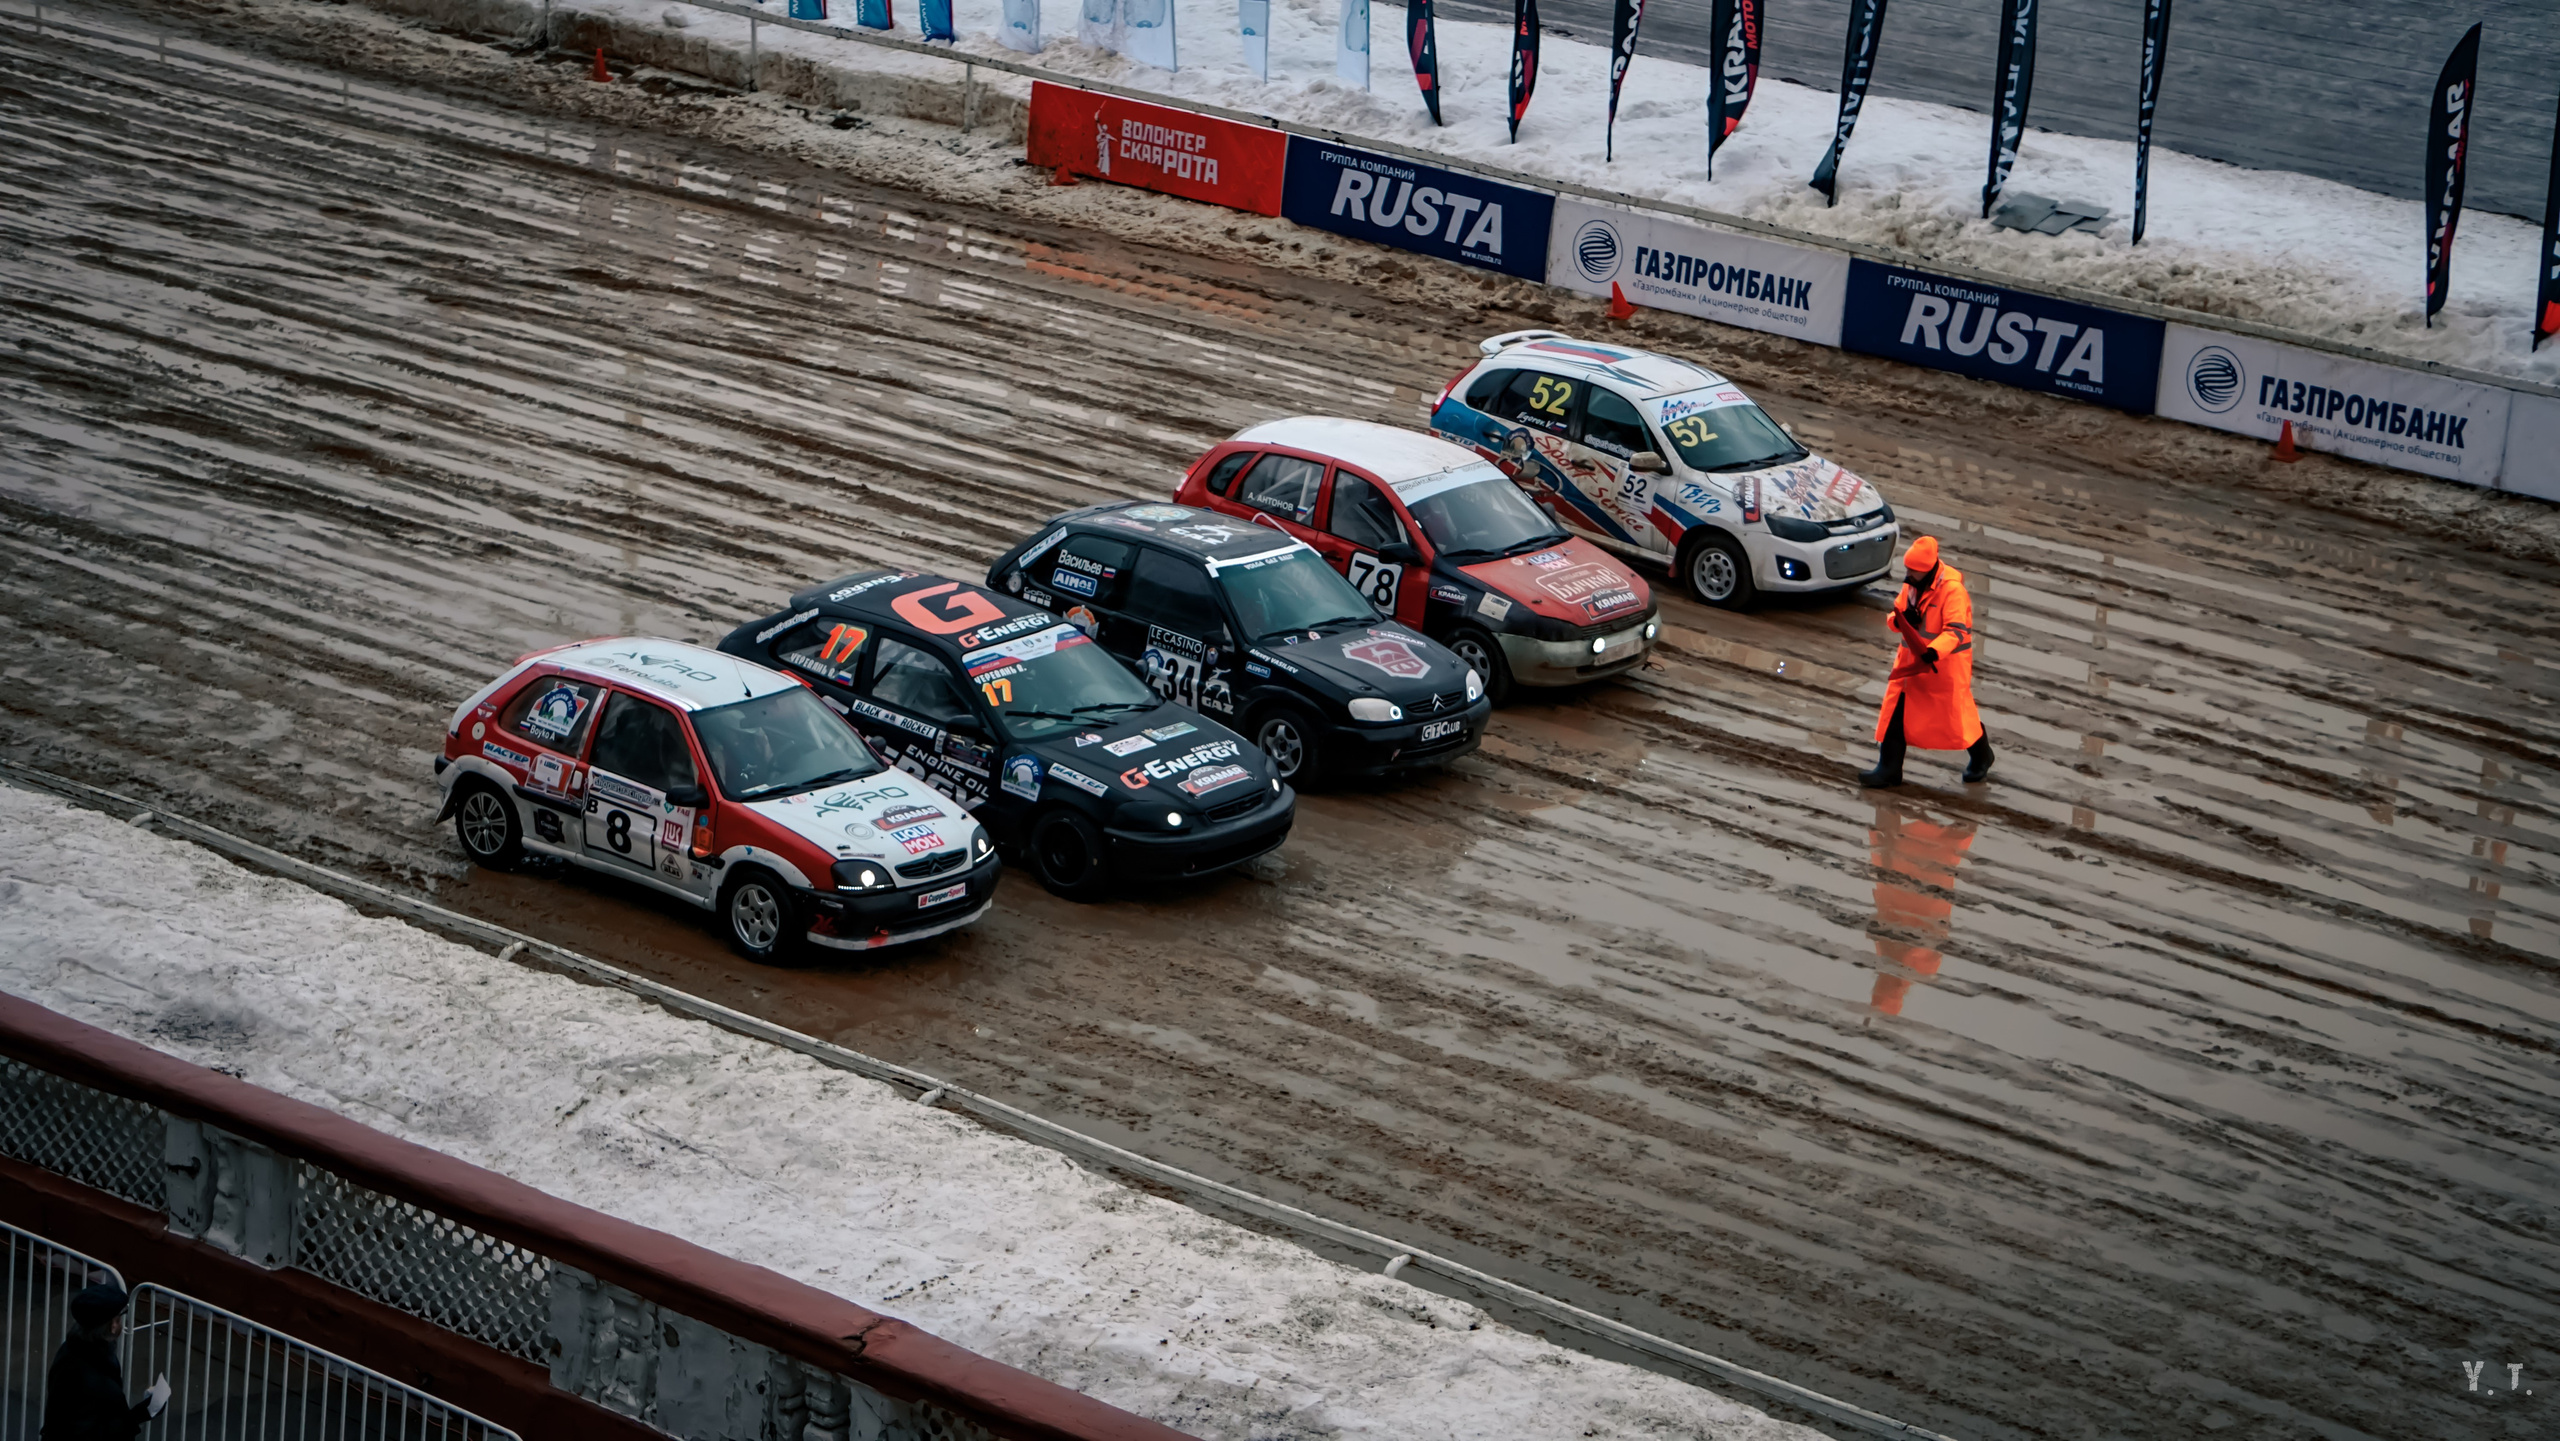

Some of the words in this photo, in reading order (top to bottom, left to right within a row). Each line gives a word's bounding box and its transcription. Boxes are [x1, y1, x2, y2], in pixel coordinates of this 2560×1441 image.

[1122, 119, 1206, 153] ВОЛОНТЕР
[1321, 150, 1358, 168] ГРУППА
[1360, 160, 1415, 181] КОМПАНИЙ
[1330, 168, 1503, 255] RUSTA
[1461, 250, 1502, 265] www.rusta.ru
[1634, 246, 1812, 311] ГАЗПРОМБАНК
[1888, 275, 1931, 293] ГРУППА
[1934, 284, 1999, 306] КОМПАНИЙ
[1632, 279, 1696, 301] «Газпромбанк»
[1699, 293, 1759, 315] (Акционерное
[1762, 307, 1807, 327] общество)
[1900, 293, 2104, 383] RUSTA
[1529, 376, 1572, 416] 52
[2055, 379, 2103, 394] www.rusta.ru
[2259, 375, 2468, 449] ГАЗПРОМБАНК
[1440, 431, 1475, 446] МАСТЕР
[1668, 416, 1719, 448] 52
[2334, 428, 2404, 452] (Акционерное
[2407, 445, 2462, 465] общество)
[1535, 436, 1598, 483] Sport
[1589, 487, 1644, 533] Service
[1623, 475, 1647, 498] 52
[1257, 495, 1294, 512] АНТОНОВ
[1680, 483, 1721, 514] ТВЕРЬ
[1021, 529, 1066, 562] МАСТЕР
[1530, 553, 1561, 565] LIQUI
[1058, 549, 1102, 576] Васильев
[1541, 560, 1574, 571] MOLY
[1023, 587, 1052, 600] GoPro
[1354, 560, 1394, 606] 78
[1595, 592, 1636, 610] KRAMAR
[820, 623, 868, 663] 17
[1151, 627, 1161, 640] LE
[1163, 632, 1202, 654] CASINO
[1249, 648, 1271, 663] Alexey
[609, 663, 682, 690] FerroLabs
[982, 678, 1013, 707] 17
[1202, 696, 1234, 715] GAZ
[529, 722, 550, 740] Boyko
[549, 730, 556, 741] A
[855, 701, 881, 718] BLACK
[901, 718, 933, 737] ROCKET
[484, 742, 530, 763] МАСТЕР
[1191, 740, 1222, 753] ENGINE
[906, 744, 964, 782] ENGINE
[965, 777, 989, 798] OIL
[1052, 764, 1105, 790] МАСТЕР
[1194, 767, 1244, 787] KRAMAR
[586, 799, 598, 814] B
[886, 805, 940, 824] KRAMAR
[606, 809, 632, 854] 8
[892, 824, 934, 842] LIQUI
[903, 834, 942, 853] MOLY
[928, 886, 965, 903] CupperSport
